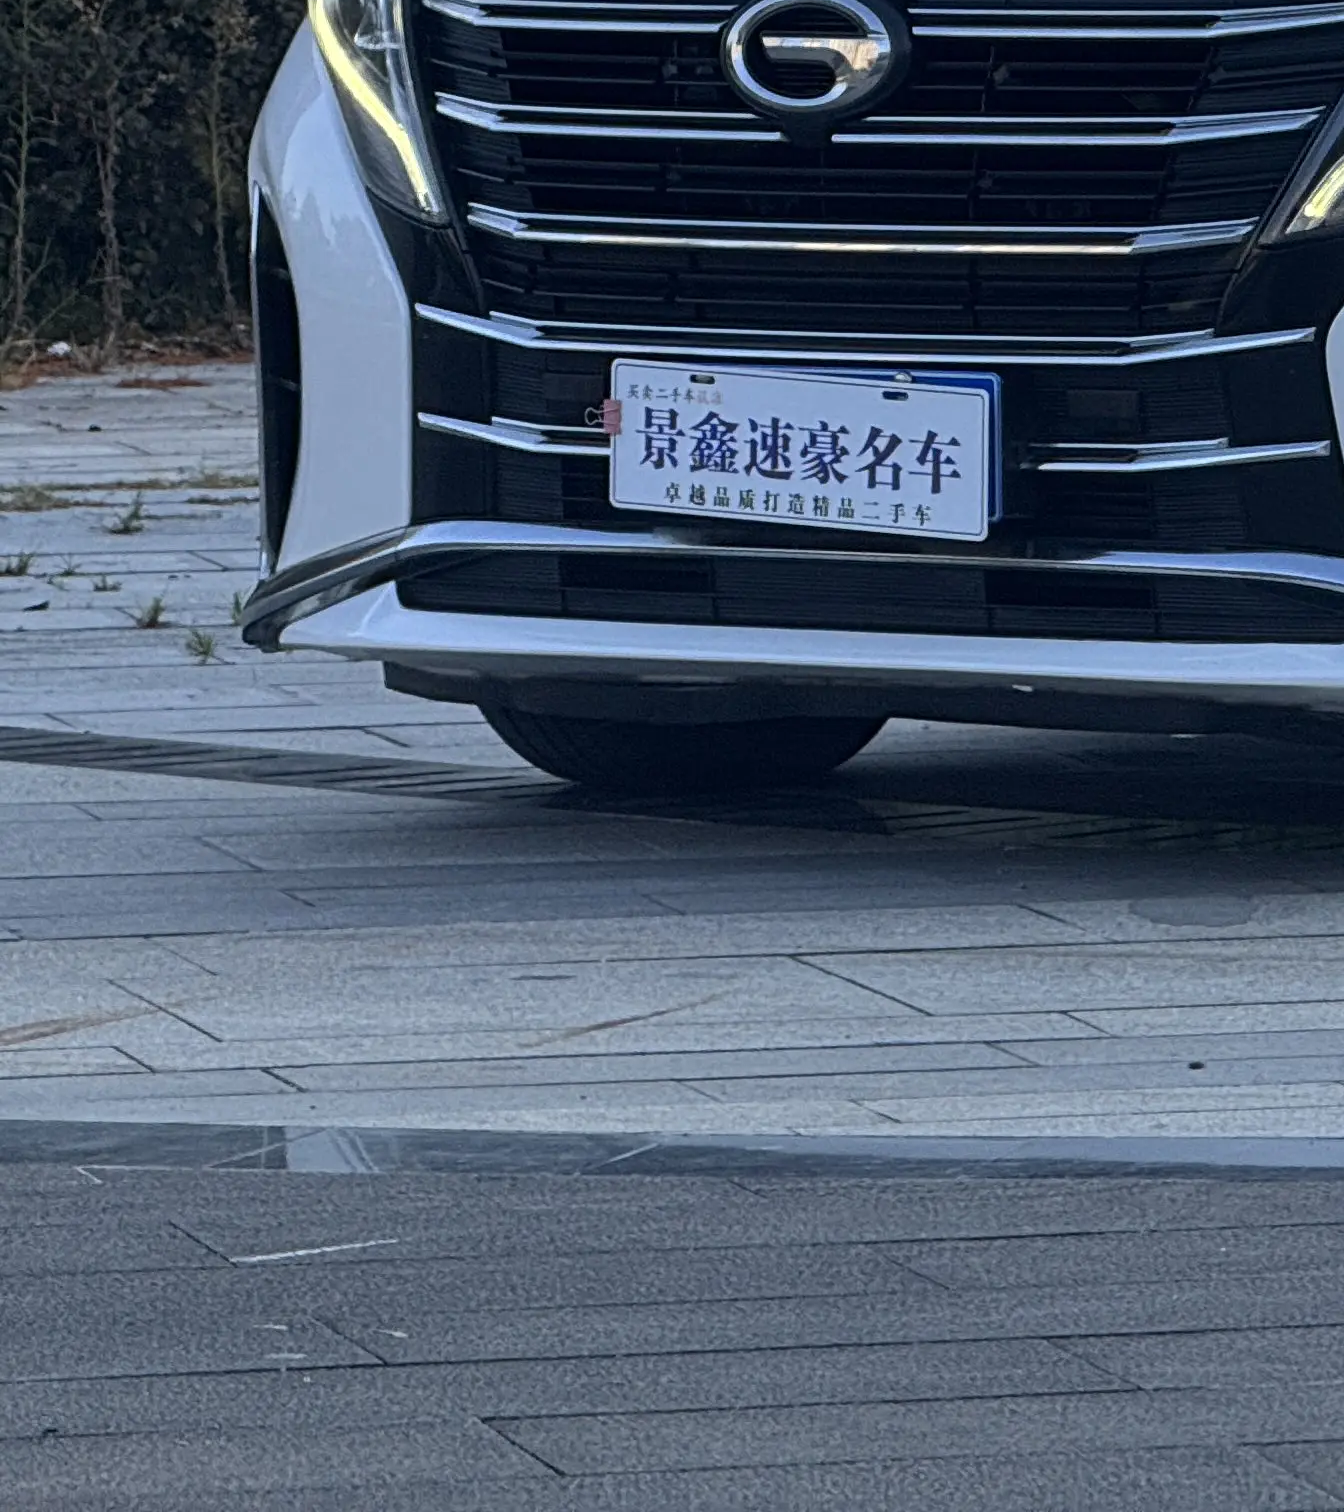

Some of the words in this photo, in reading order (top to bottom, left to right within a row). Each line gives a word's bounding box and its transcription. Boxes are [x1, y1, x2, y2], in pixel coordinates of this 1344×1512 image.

[635, 406, 961, 494] 景鑫速豪名车
[664, 481, 932, 526] 卓越品质打造精品二手车
